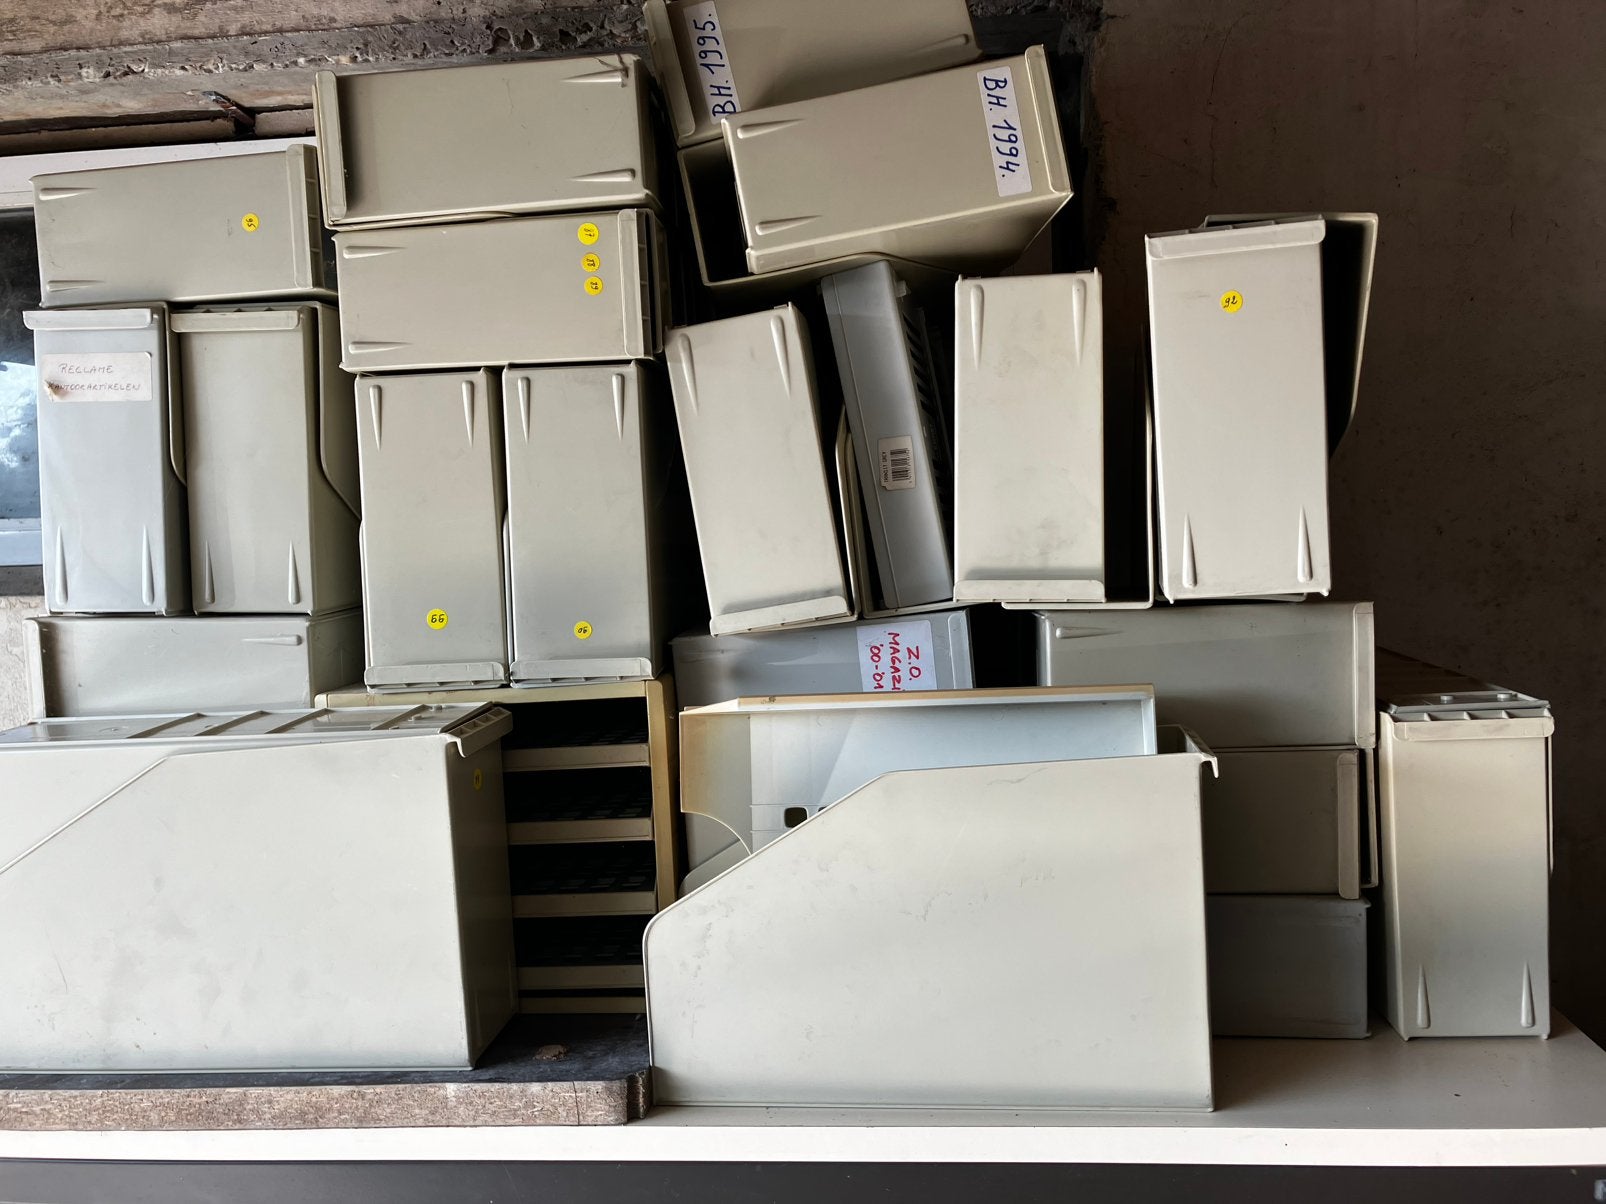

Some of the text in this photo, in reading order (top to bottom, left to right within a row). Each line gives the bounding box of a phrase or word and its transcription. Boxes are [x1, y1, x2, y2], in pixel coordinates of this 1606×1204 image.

[692, 13, 737, 117] BH. 1995.
[982, 76, 1020, 178] BH. 1994.
[58, 362, 114, 375] RECLAME
[906, 645, 922, 681] Z.O.
